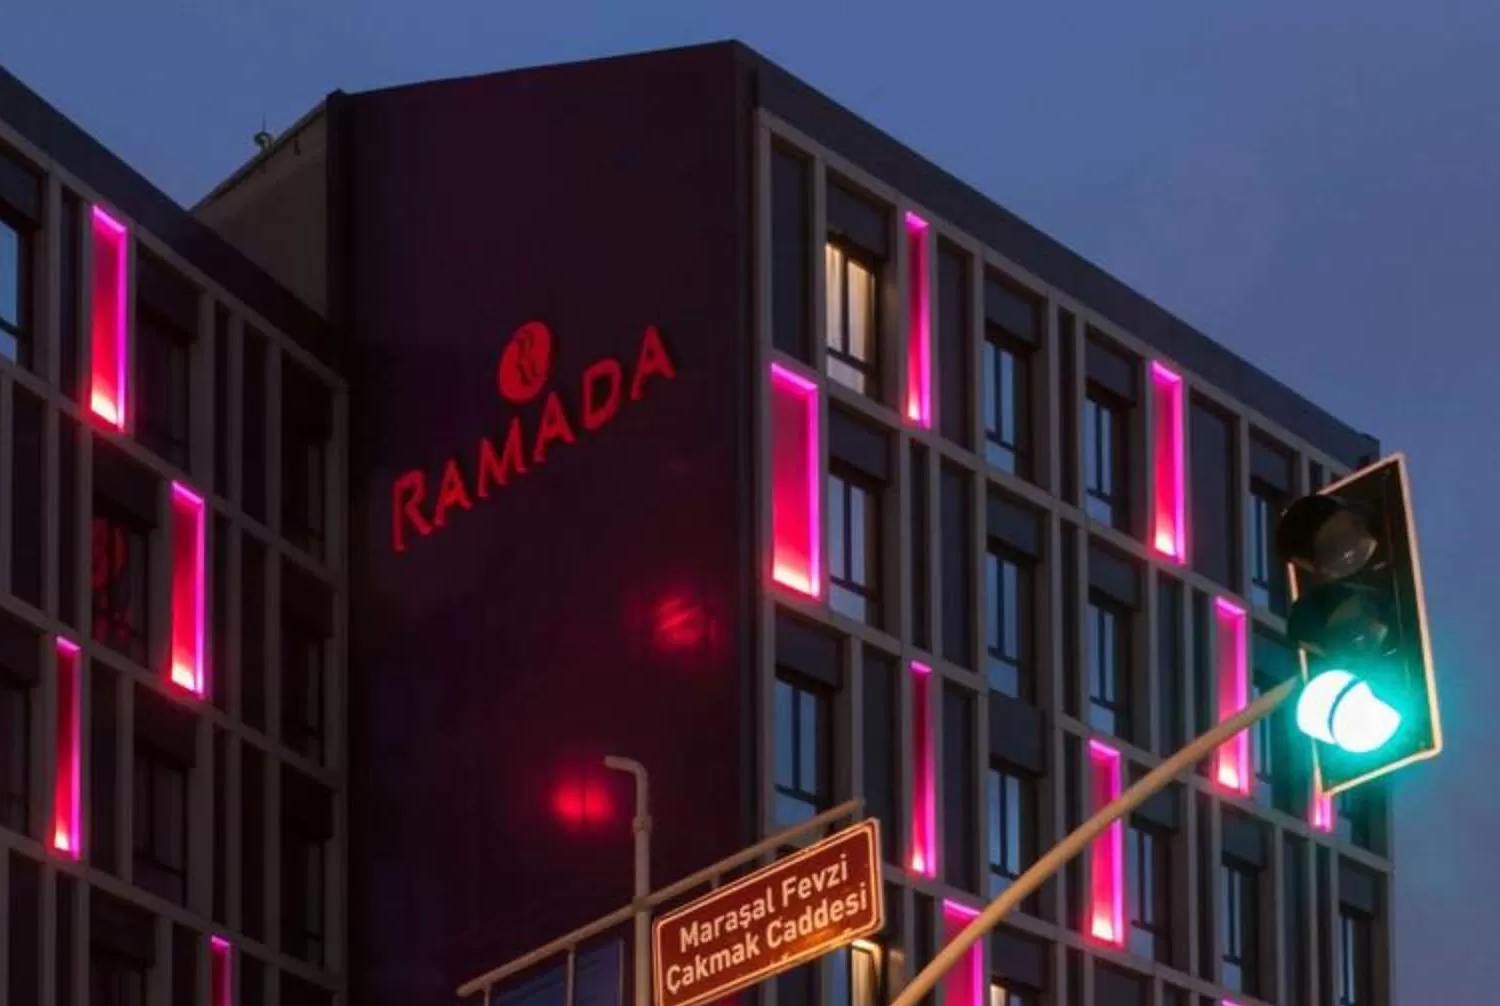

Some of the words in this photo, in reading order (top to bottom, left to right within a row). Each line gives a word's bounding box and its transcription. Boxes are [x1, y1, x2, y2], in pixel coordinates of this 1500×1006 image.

[392, 324, 676, 552] RAMADA
[666, 933, 761, 995] Çakmak
[766, 882, 868, 949] Caddesi
[679, 887, 776, 953] Maraşal
[781, 853, 849, 908] Fevzi
